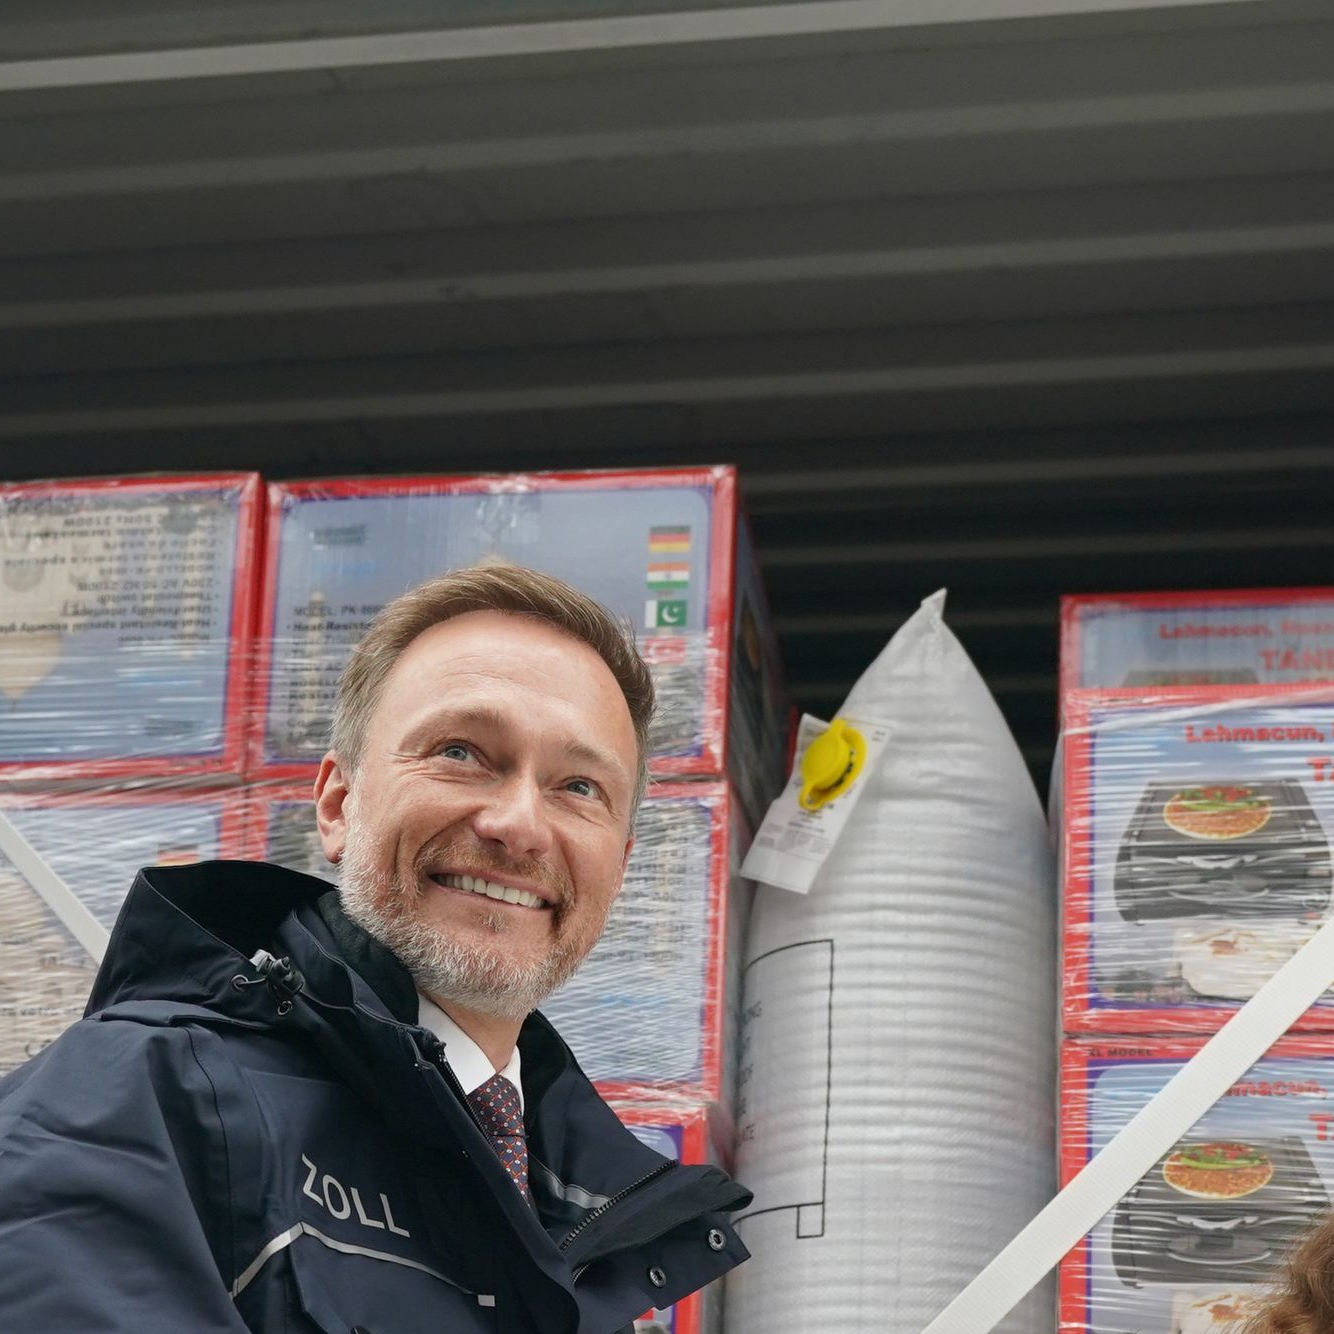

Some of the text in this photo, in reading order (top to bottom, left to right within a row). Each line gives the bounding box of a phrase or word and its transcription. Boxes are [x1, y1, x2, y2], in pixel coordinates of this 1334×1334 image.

[1184, 722, 1327, 745] Lahmacun,
[1107, 1047, 1154, 1057] MODEL
[302, 1153, 411, 1239] ZOLL
